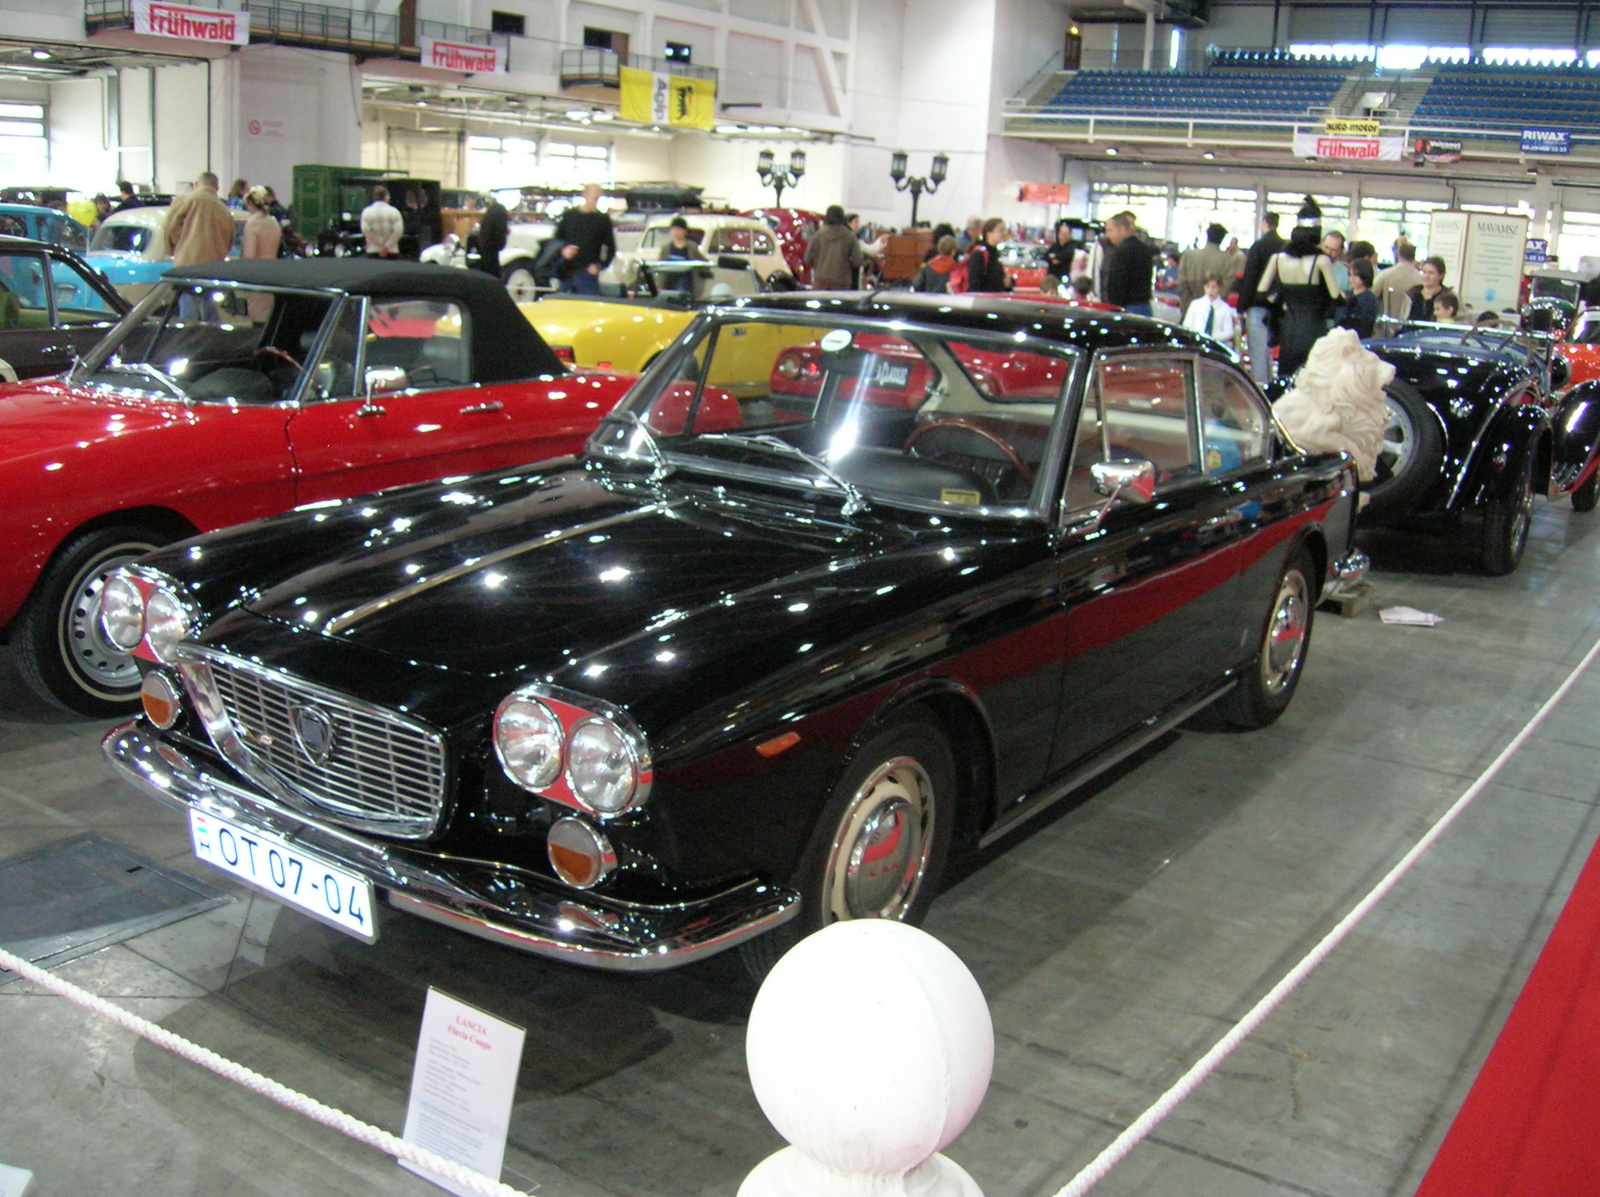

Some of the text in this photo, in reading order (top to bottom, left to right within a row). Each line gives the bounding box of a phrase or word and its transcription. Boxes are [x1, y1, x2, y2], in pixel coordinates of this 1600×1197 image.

[149, 4, 235, 41] Frühwald
[433, 41, 496, 72] Frühwald
[654, 77, 667, 120] Agip
[1316, 138, 1380, 158] Frühwald
[1523, 130, 1565, 141] RIWAX
[219, 828, 364, 926] OT 07-04
[456, 1015, 487, 1036] LANCIA
